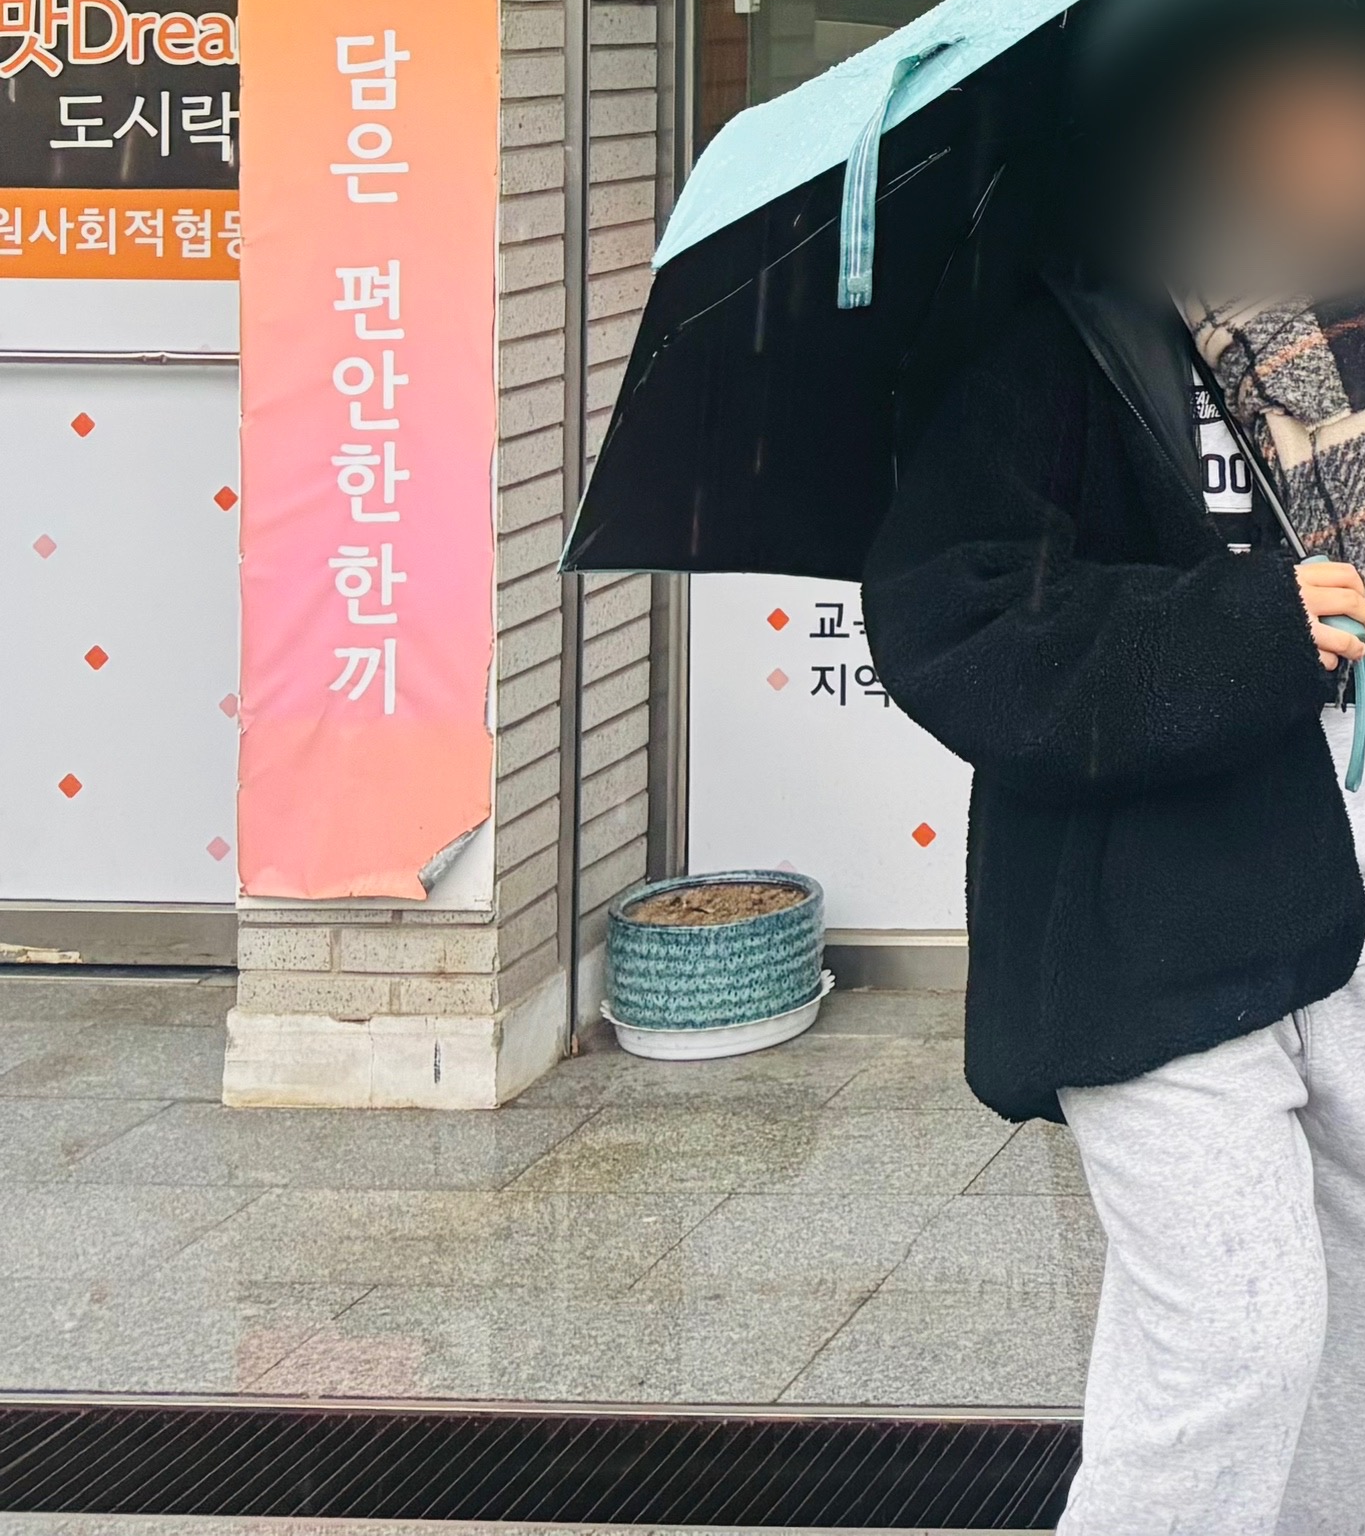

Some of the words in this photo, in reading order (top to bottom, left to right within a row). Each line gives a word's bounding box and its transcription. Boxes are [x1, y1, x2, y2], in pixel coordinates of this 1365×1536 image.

[49, 90, 239, 163] 도시락
[329, 29, 410, 205] 담은
[330, 259, 410, 524] 편안한
[328, 543, 407, 716] 한끼
[809, 602, 866, 638] 교
